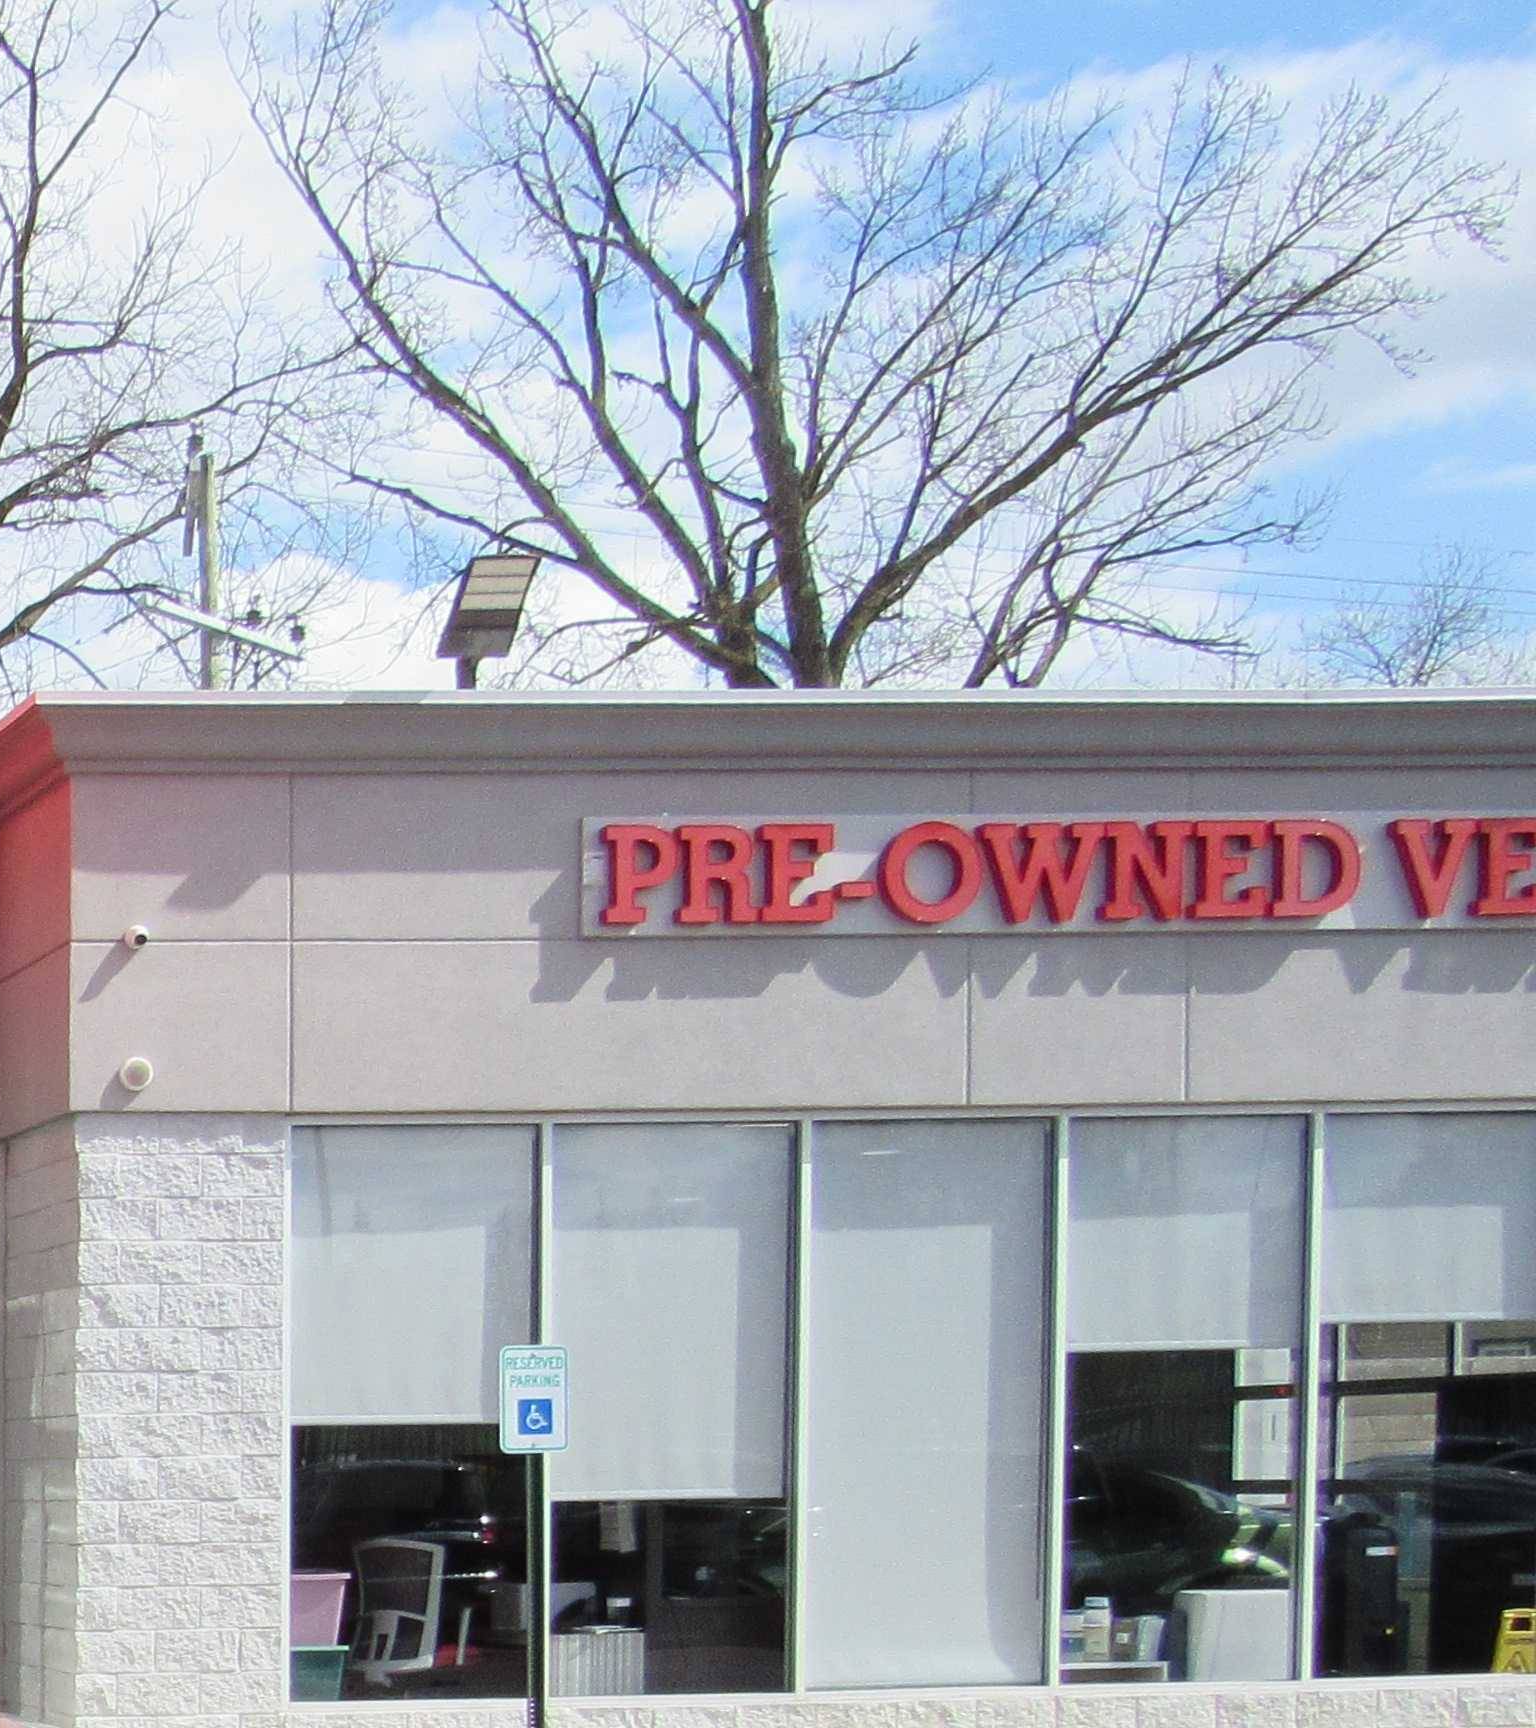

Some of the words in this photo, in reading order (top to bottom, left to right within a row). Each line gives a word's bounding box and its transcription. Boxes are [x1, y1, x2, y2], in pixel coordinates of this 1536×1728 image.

[600, 818, 1361, 926] PRE-OWNED
[1386, 816, 1536, 920] VE
[506, 1356, 564, 1370] RESERVED
[510, 1374, 561, 1388] PARKING
